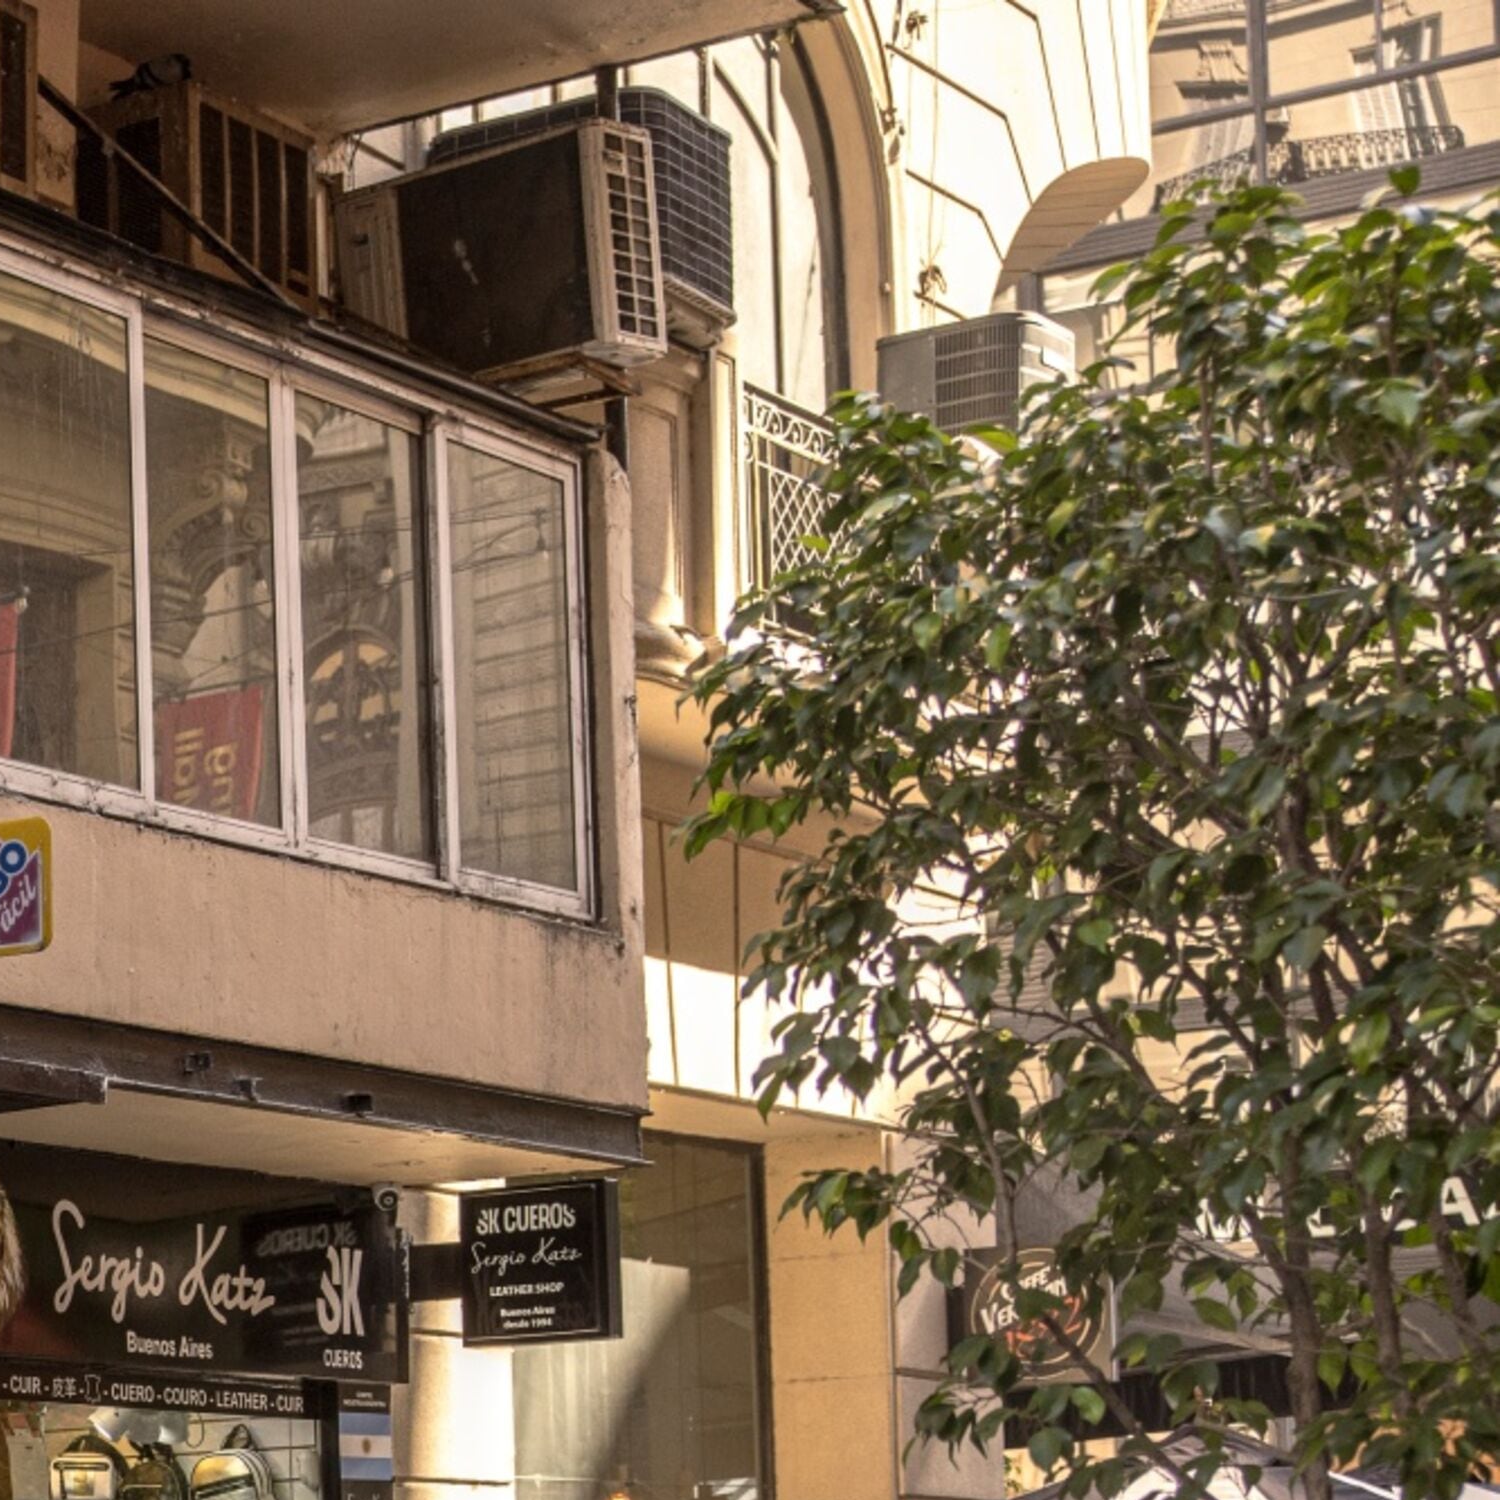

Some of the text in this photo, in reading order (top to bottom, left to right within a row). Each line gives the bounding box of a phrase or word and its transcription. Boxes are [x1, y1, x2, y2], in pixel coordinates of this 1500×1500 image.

[476, 1202, 576, 1235] SK CUEROS
[53, 1201, 275, 1325] Sergio Katz
[471, 1237, 582, 1276] Sergio Katz
[317, 1246, 364, 1335] SK
[489, 1282, 565, 1297] LEATHER SHOP
[500, 1305, 556, 1317] Buenos Aires
[127, 1331, 212, 1360] Buenos Aires
[323, 1349, 363, 1370] CUEROS
[10, 1376, 42, 1395] CUIR
[52, 1377, 76, 1398] 皮革
[111, 1383, 153, 1402] CUERO
[163, 1387, 206, 1407] COURO
[217, 1391, 268, 1410] LEATHER
[276, 1394, 304, 1413] CUIR
